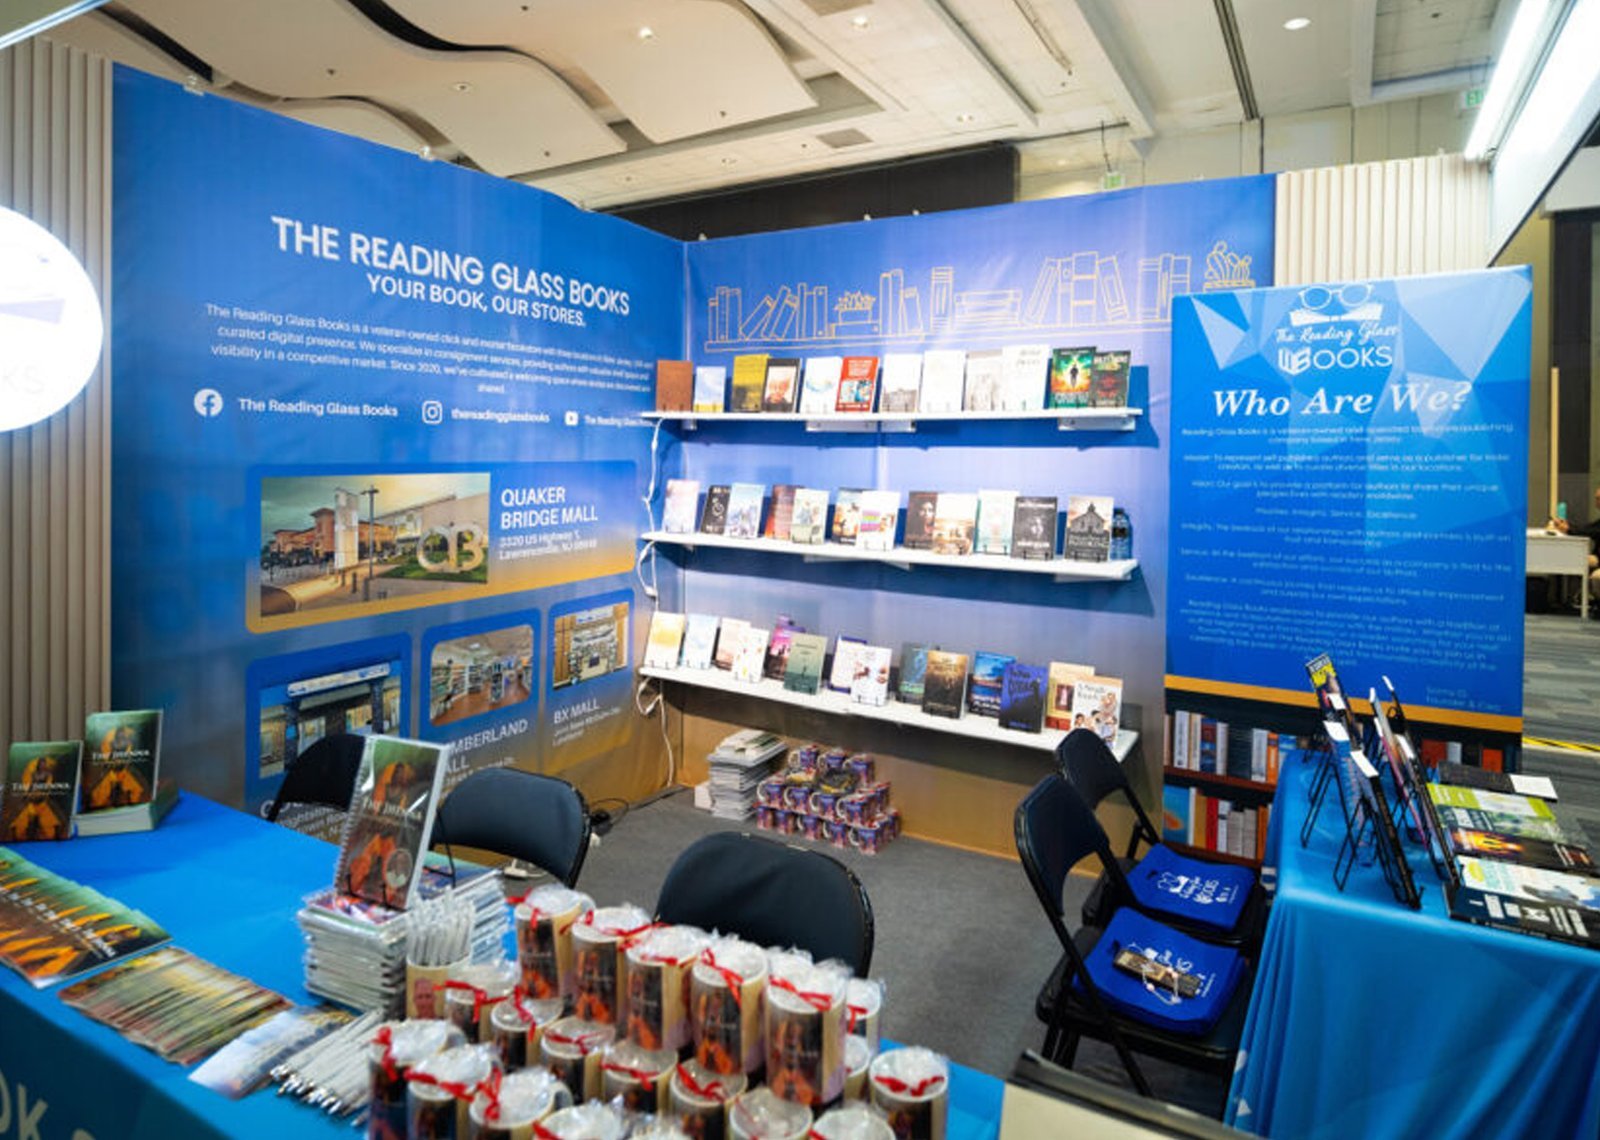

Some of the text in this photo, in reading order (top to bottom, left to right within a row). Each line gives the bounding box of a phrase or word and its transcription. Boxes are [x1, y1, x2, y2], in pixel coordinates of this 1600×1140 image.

[271, 215, 630, 316] THE READING GLASS BOOKS
[367, 272, 586, 328] YOUR BOOK, OUR STORES.
[205, 303, 231, 318] The
[233, 307, 283, 326] Reading
[285, 313, 316, 328] Glass
[318, 316, 350, 333] Books
[217, 326, 265, 341] curated
[268, 330, 304, 346] digital
[1276, 320, 1399, 347] The Reading Glass
[211, 345, 261, 361] visibility
[264, 347, 276, 359] in
[277, 350, 285, 360] a
[286, 351, 350, 366] competitive
[238, 397, 398, 418] The Reading Glass Books
[1213, 380, 1473, 417] Who Are We?
[501, 487, 566, 507] QUAKER
[501, 507, 598, 531] BRIDGE MALL
[553, 697, 600, 724] BX MALL
[447, 719, 529, 756] MBERLAND
[445, 755, 470, 773] ALL
